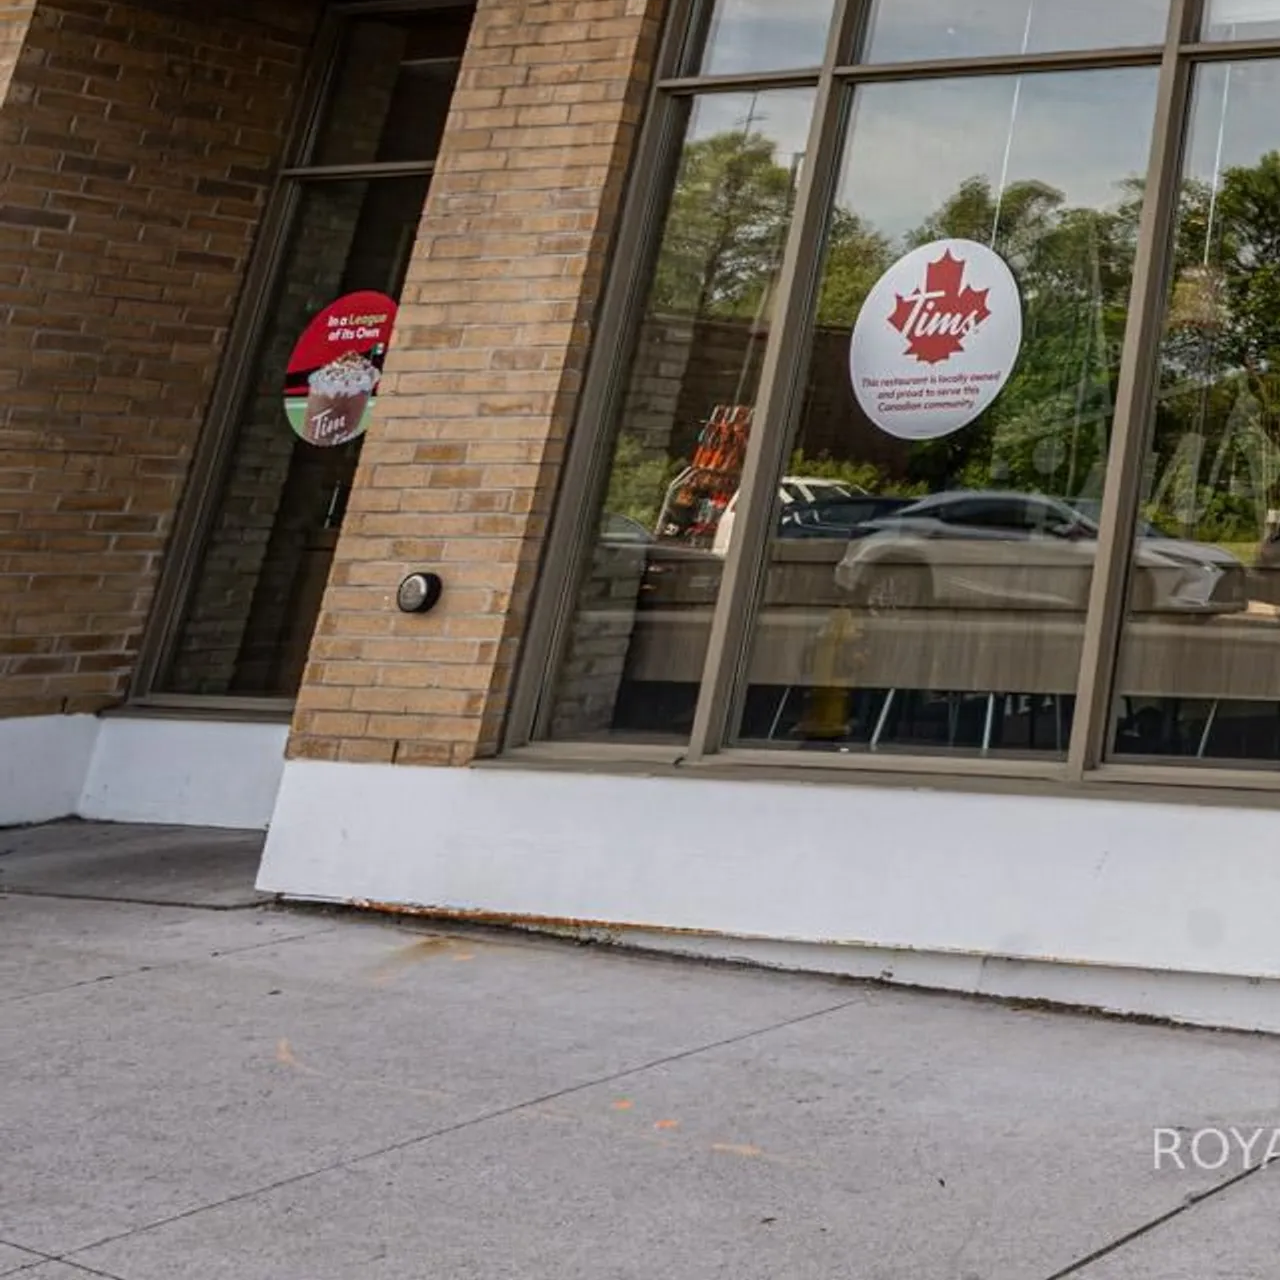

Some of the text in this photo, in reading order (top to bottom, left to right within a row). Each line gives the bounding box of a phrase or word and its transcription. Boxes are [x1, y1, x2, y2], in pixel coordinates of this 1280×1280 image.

[903, 290, 979, 337] Tims
[879, 376, 928, 387] restaurant
[938, 373, 968, 384] locally
[878, 385, 979, 400] and proud to serve this
[878, 402, 921, 412] Canadian
